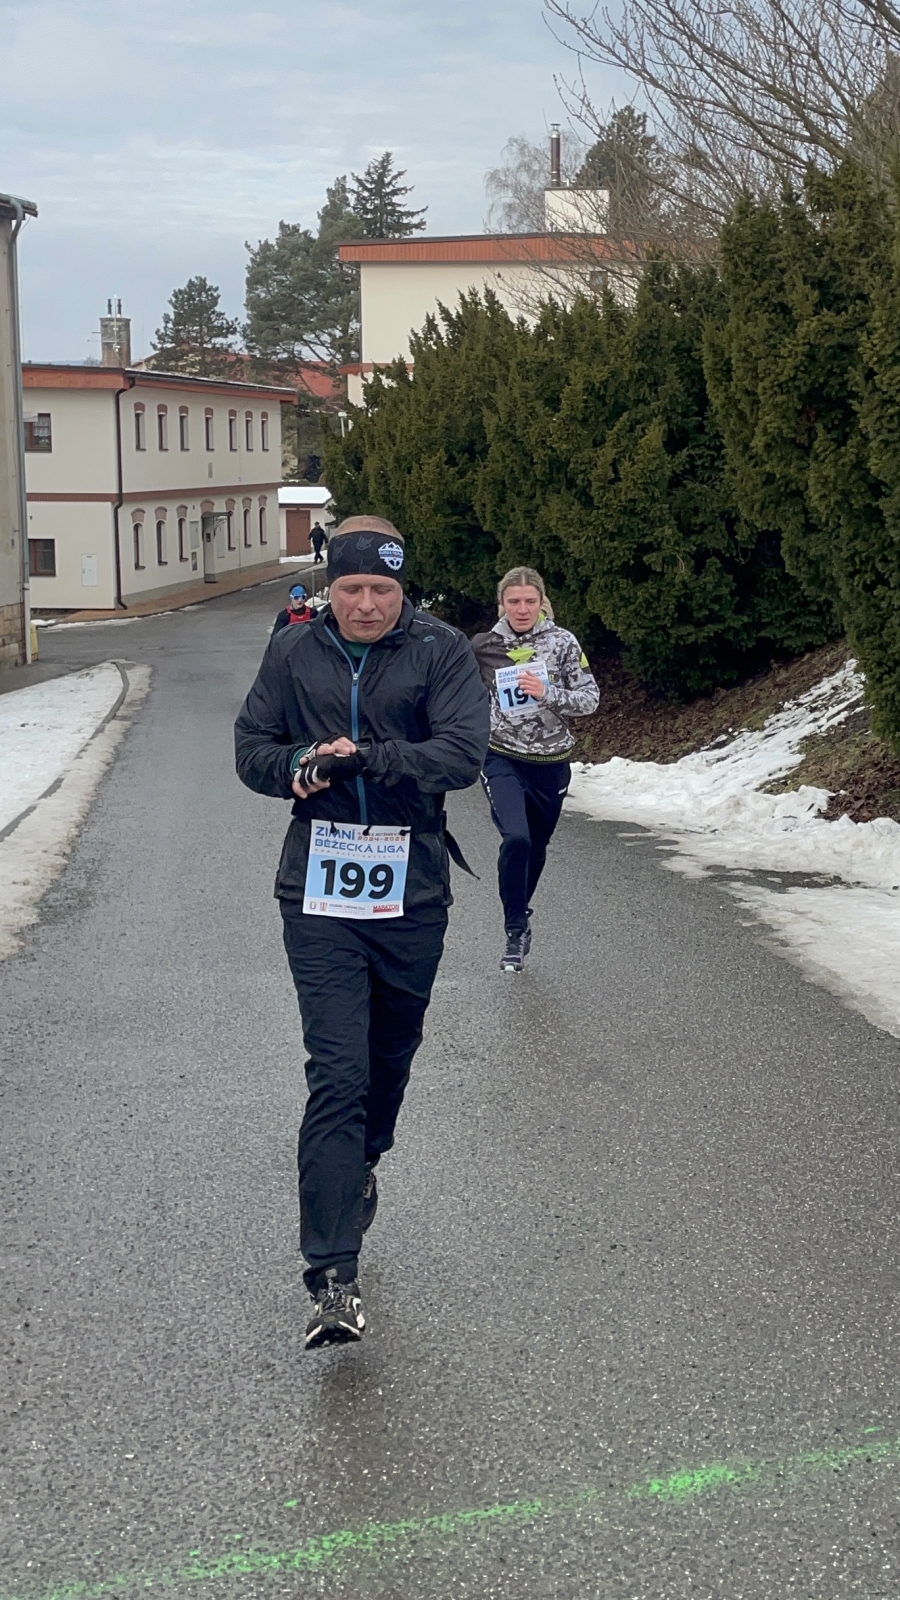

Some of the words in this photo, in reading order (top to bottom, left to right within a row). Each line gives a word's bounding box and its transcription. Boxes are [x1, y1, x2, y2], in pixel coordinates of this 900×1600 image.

[503, 686, 540, 706] 19
[315, 826, 356, 840] ZIMNÍ
[314, 838, 373, 853] BĚŽECKÁ
[377, 845, 405, 853] LIGA
[320, 859, 394, 900] 199
